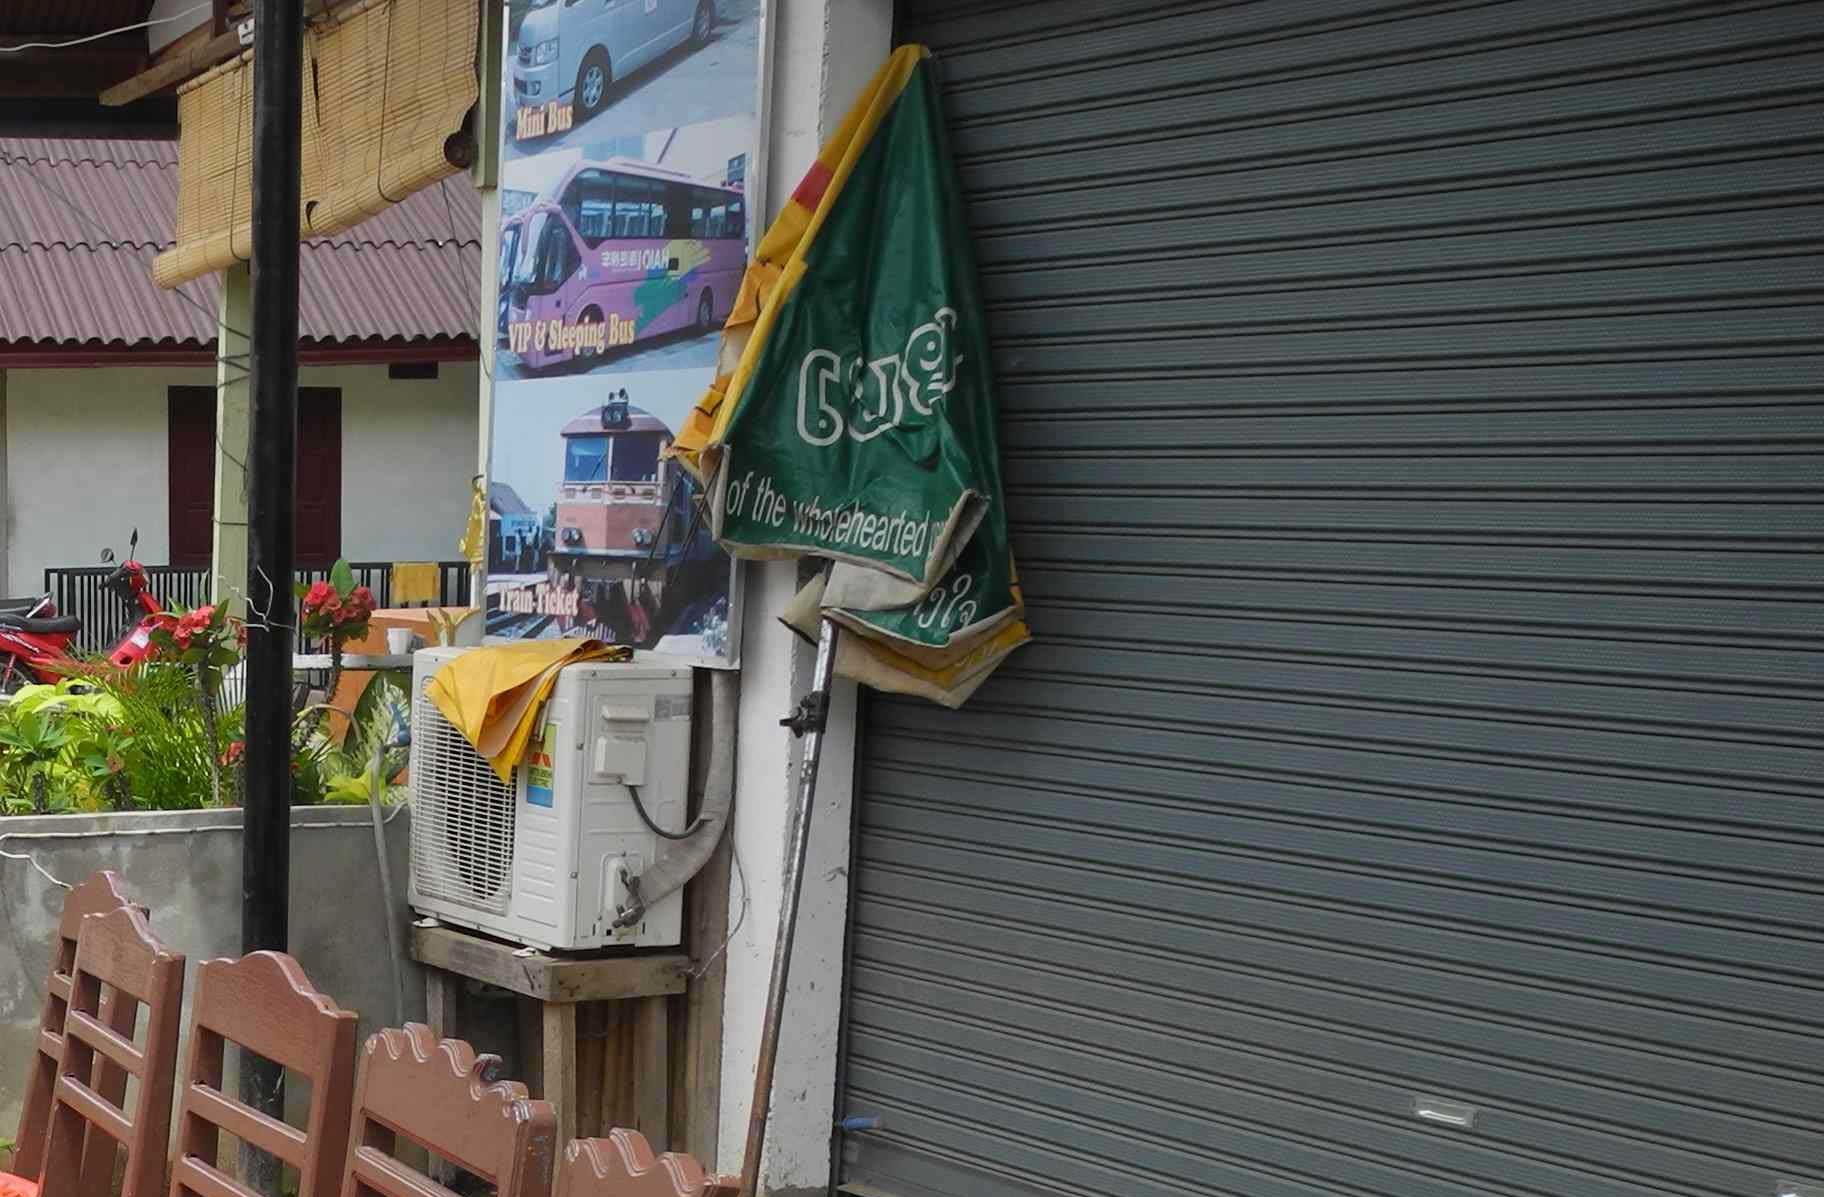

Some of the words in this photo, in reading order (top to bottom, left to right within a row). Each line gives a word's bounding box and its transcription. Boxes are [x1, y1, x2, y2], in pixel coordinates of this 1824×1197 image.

[516, 104, 545, 140] Mini
[547, 100, 573, 134] Bus
[508, 321, 532, 353] VIP
[535, 320, 547, 351] &
[547, 315, 606, 355] Sleeping
[608, 313, 636, 345] Bus
[726, 471, 755, 517] of
[751, 477, 787, 528] the
[792, 495, 930, 557] wholehearted
[497, 581, 580, 616] Train-Ticket
